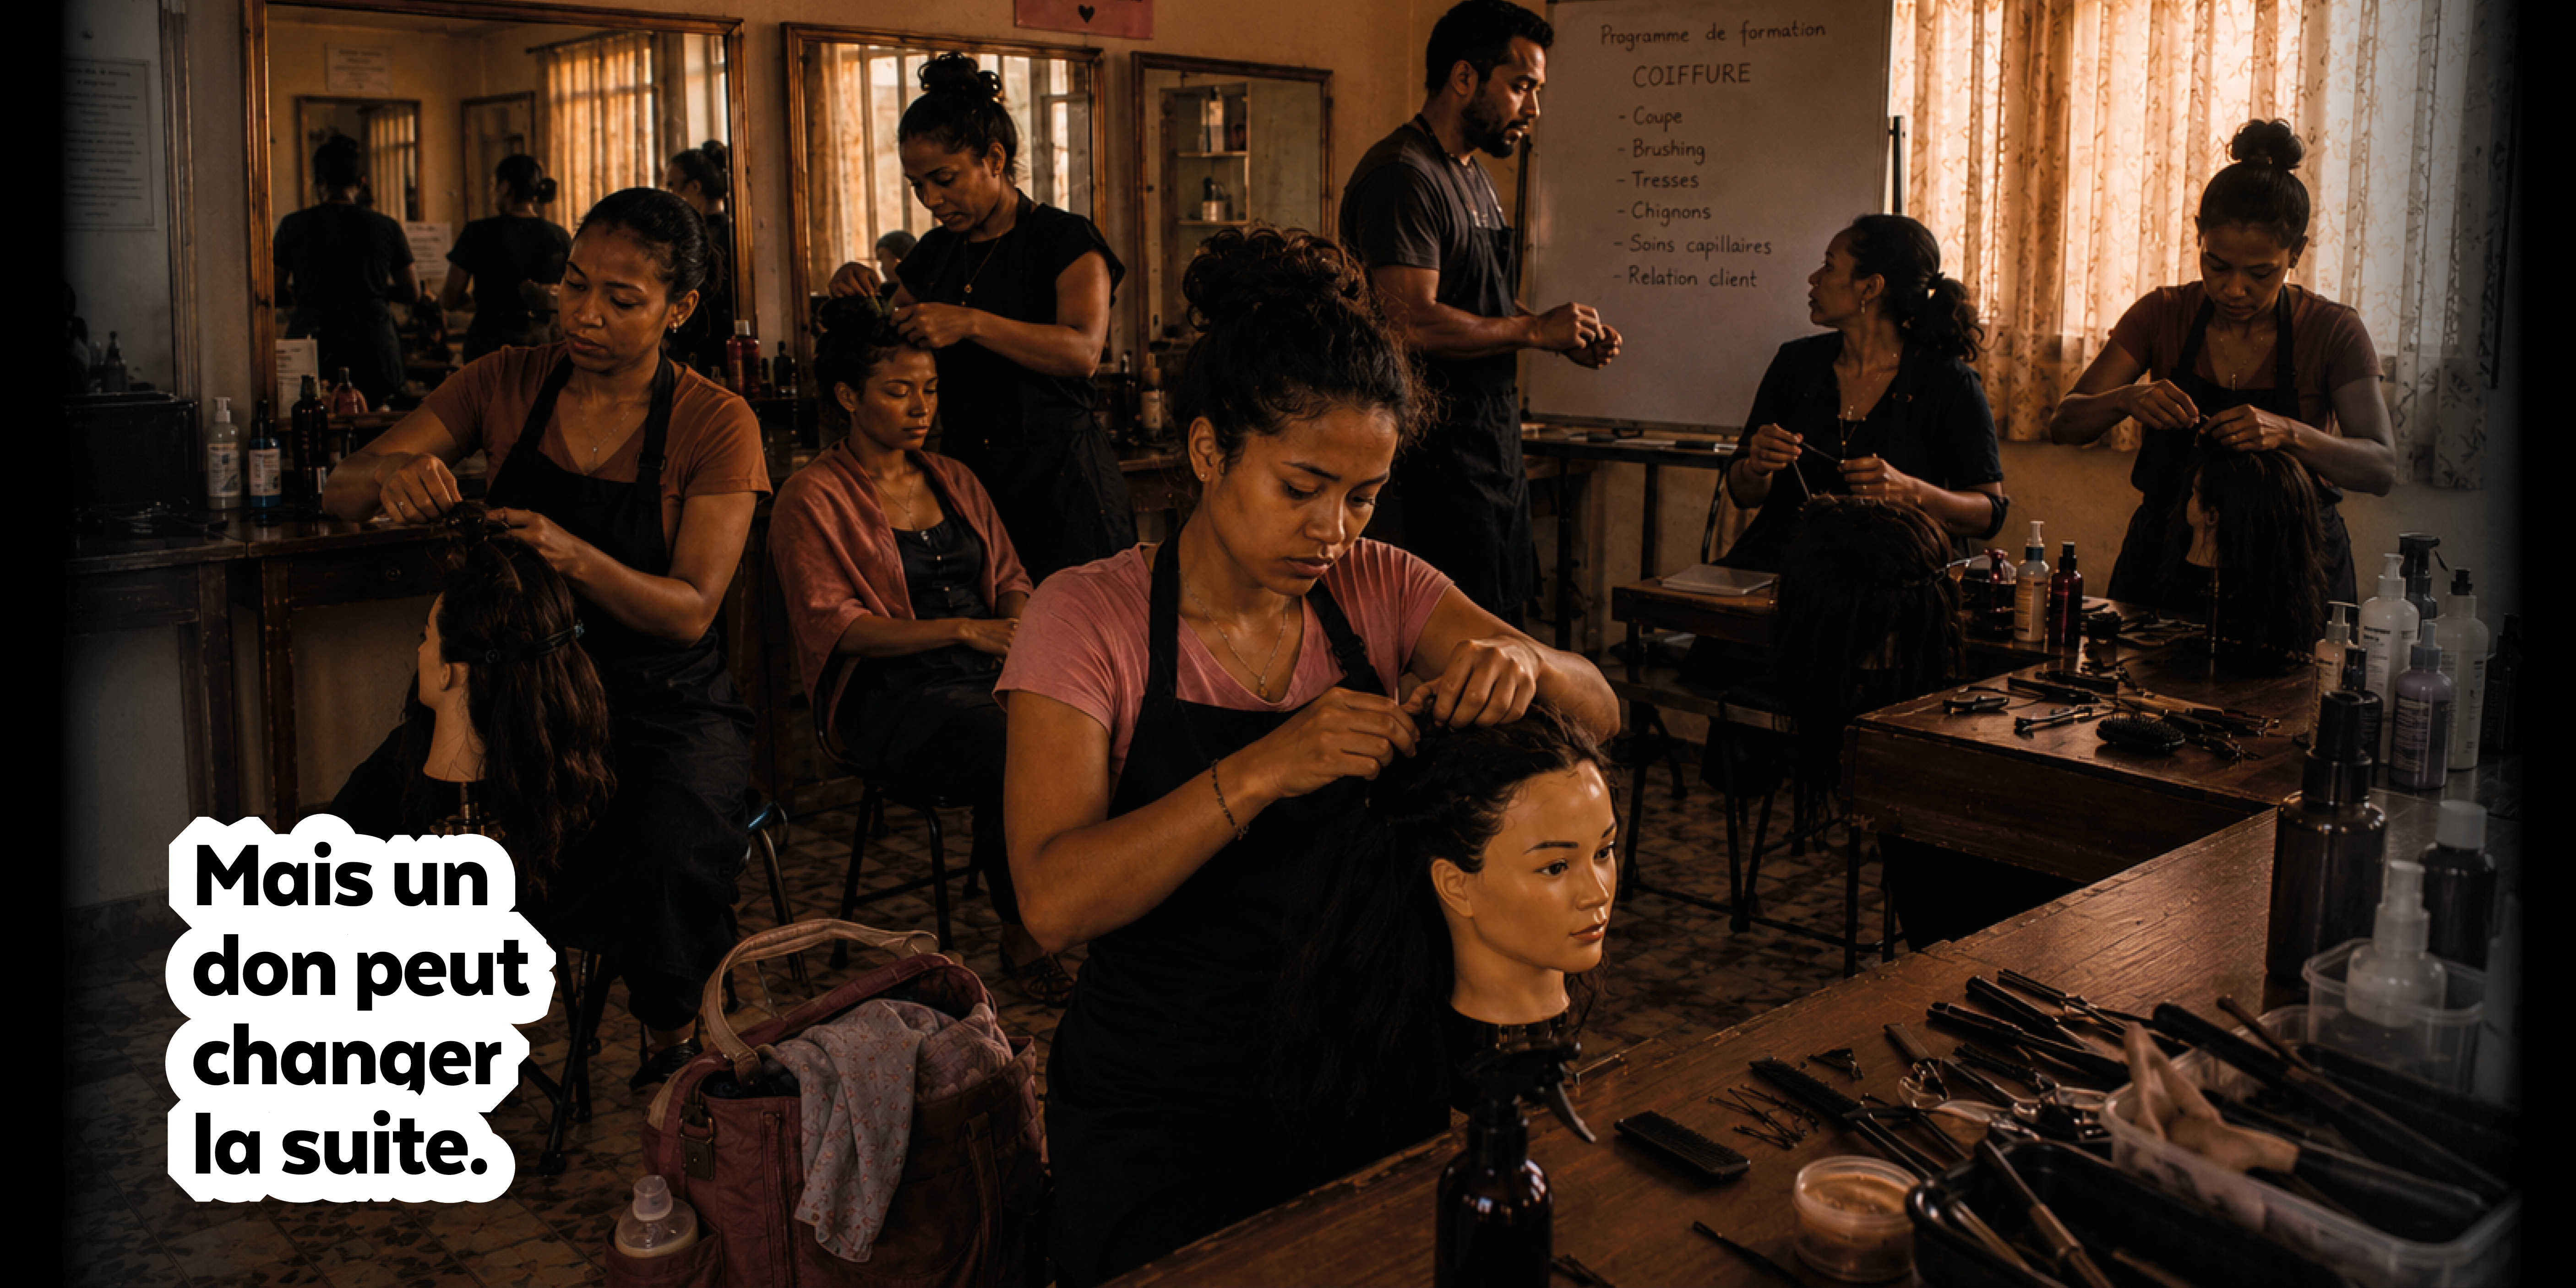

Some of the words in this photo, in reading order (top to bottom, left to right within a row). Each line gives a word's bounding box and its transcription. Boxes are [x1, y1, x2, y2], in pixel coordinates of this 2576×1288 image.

[1601, 24, 1689, 52] Programme
[1705, 22, 1726, 41] de
[1740, 20, 1826, 47] formation
[1633, 62, 1750, 88] COIFFURE
[1633, 106, 1683, 132] Coupe
[1633, 138, 1705, 165] Brushing
[1631, 170, 1699, 188] Tresses
[1631, 201, 1711, 227] Chignons
[1629, 234, 1675, 253] Soins
[1686, 235, 1771, 261] capillaires
[1629, 265, 1697, 286] Relation
[1709, 268, 1757, 288] client
